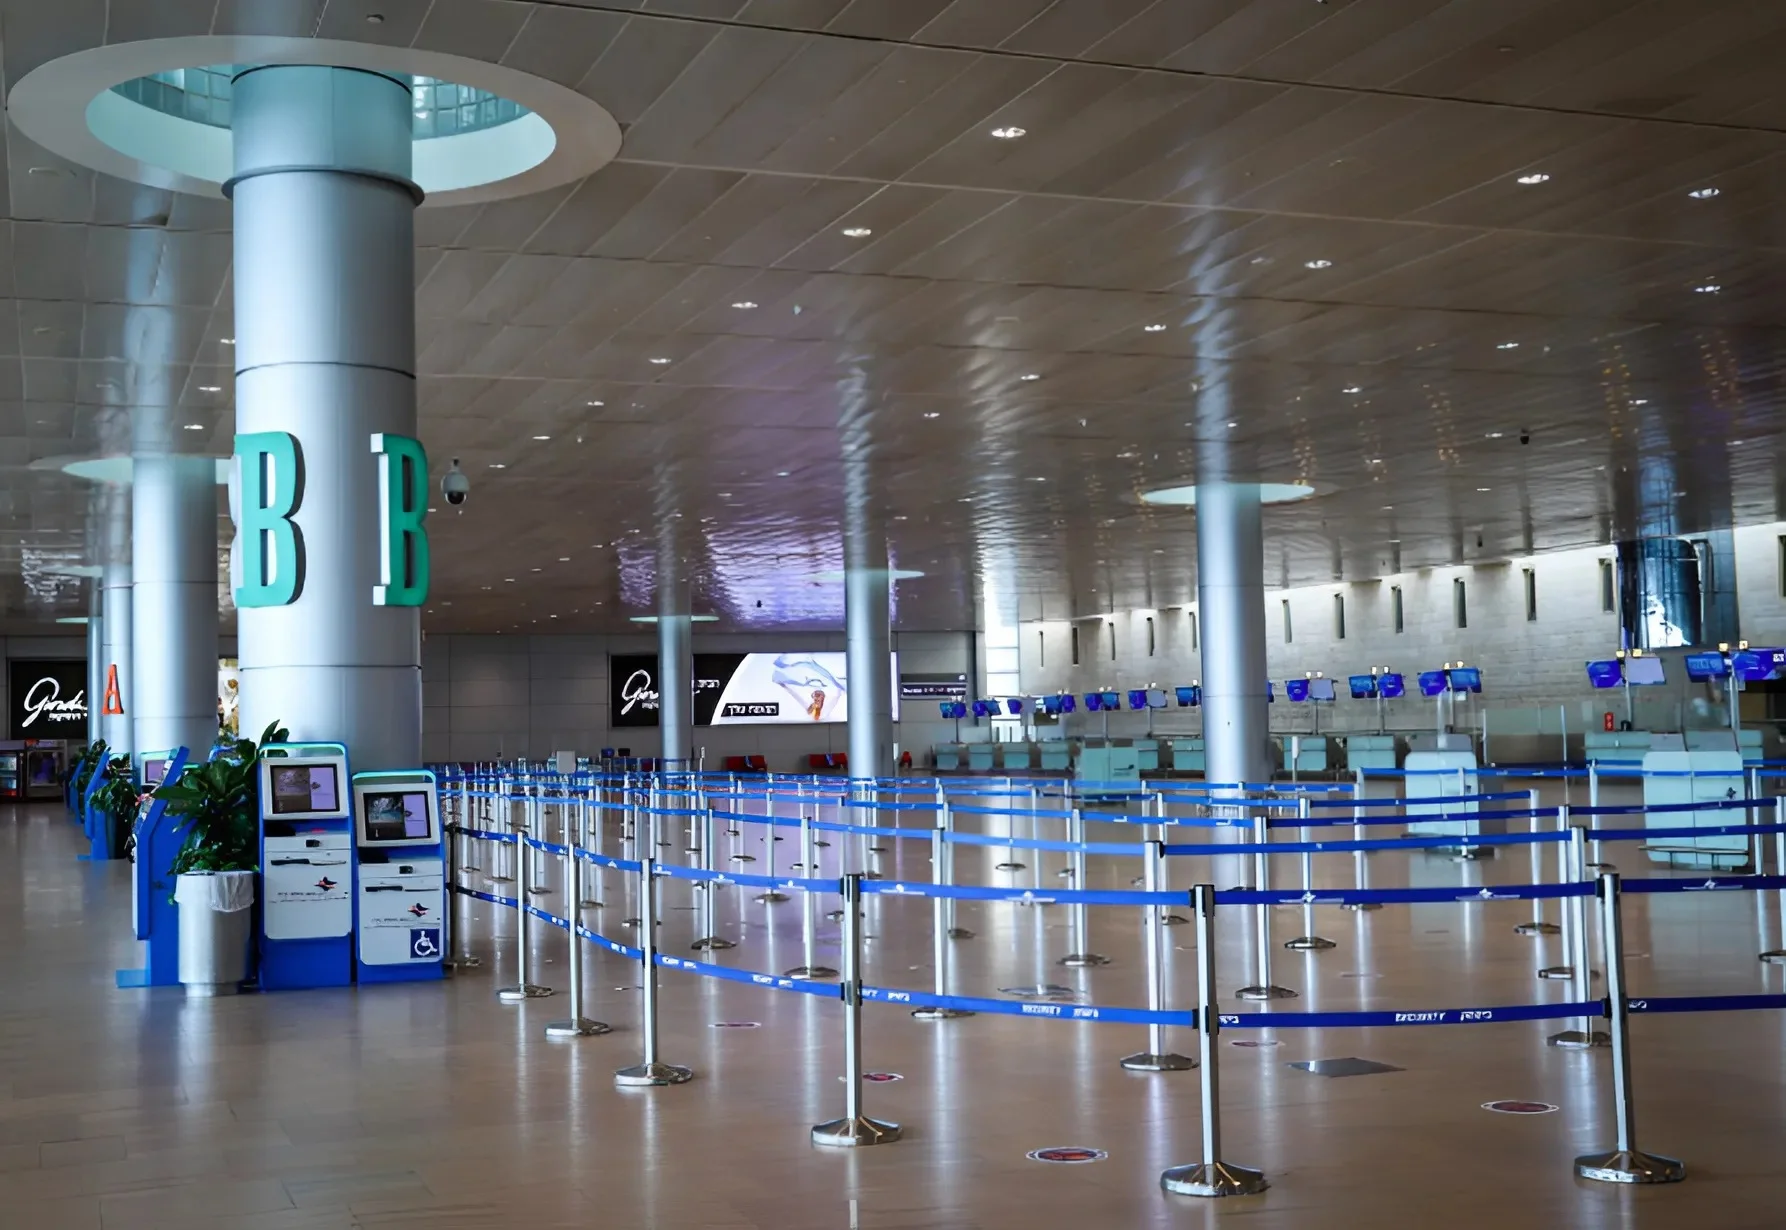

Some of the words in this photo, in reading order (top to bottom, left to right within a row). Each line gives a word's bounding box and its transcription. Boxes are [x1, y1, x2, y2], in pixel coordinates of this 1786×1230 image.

[234, 431, 305, 608] B
[371, 433, 430, 607] B
[101, 664, 124, 715] A
